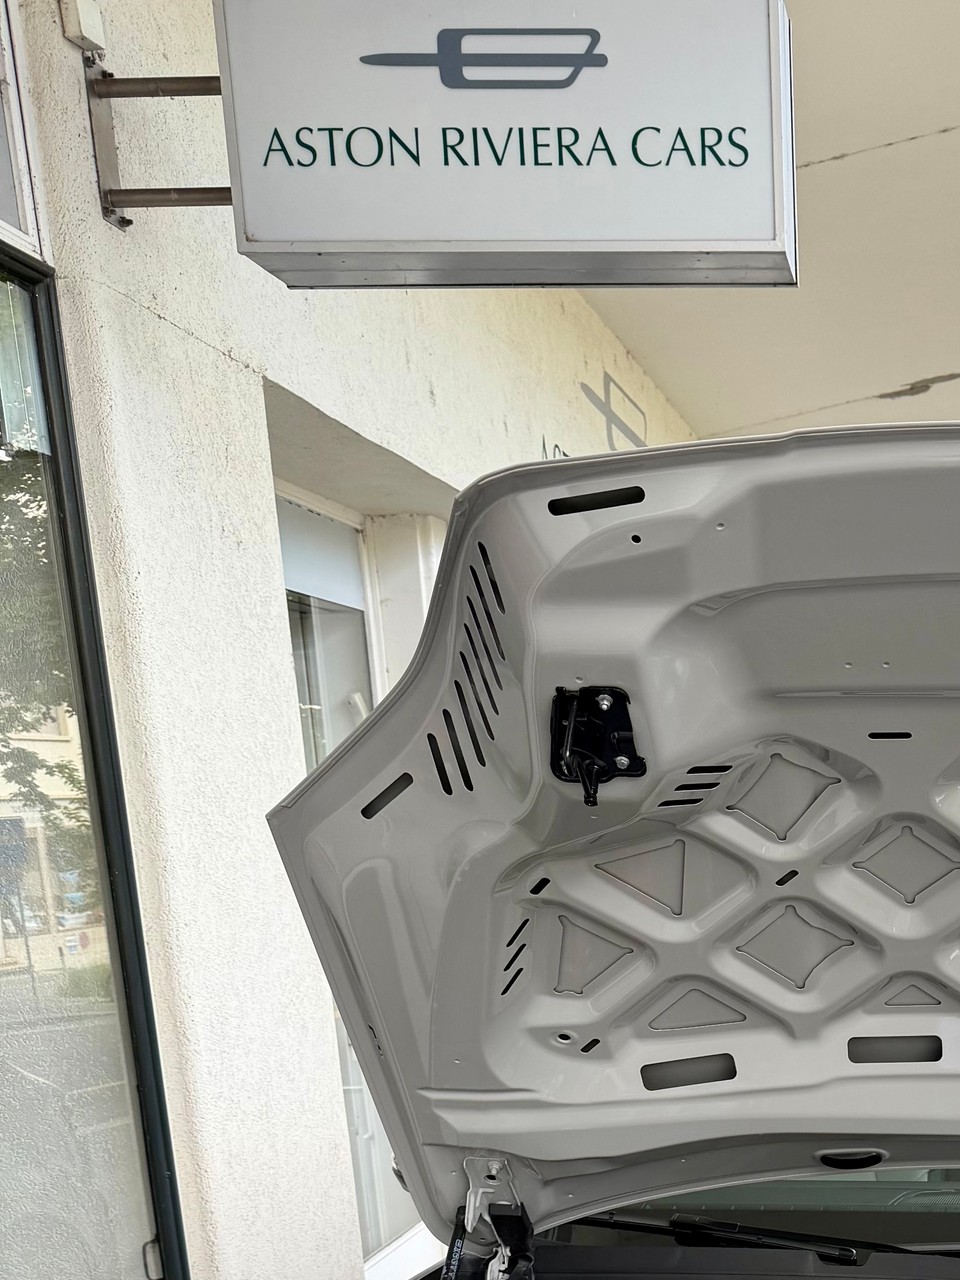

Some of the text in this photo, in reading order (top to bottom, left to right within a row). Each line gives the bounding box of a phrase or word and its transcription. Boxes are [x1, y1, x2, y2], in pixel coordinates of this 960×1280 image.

[262, 126, 750, 168] ASTON RIVIERA CARS
